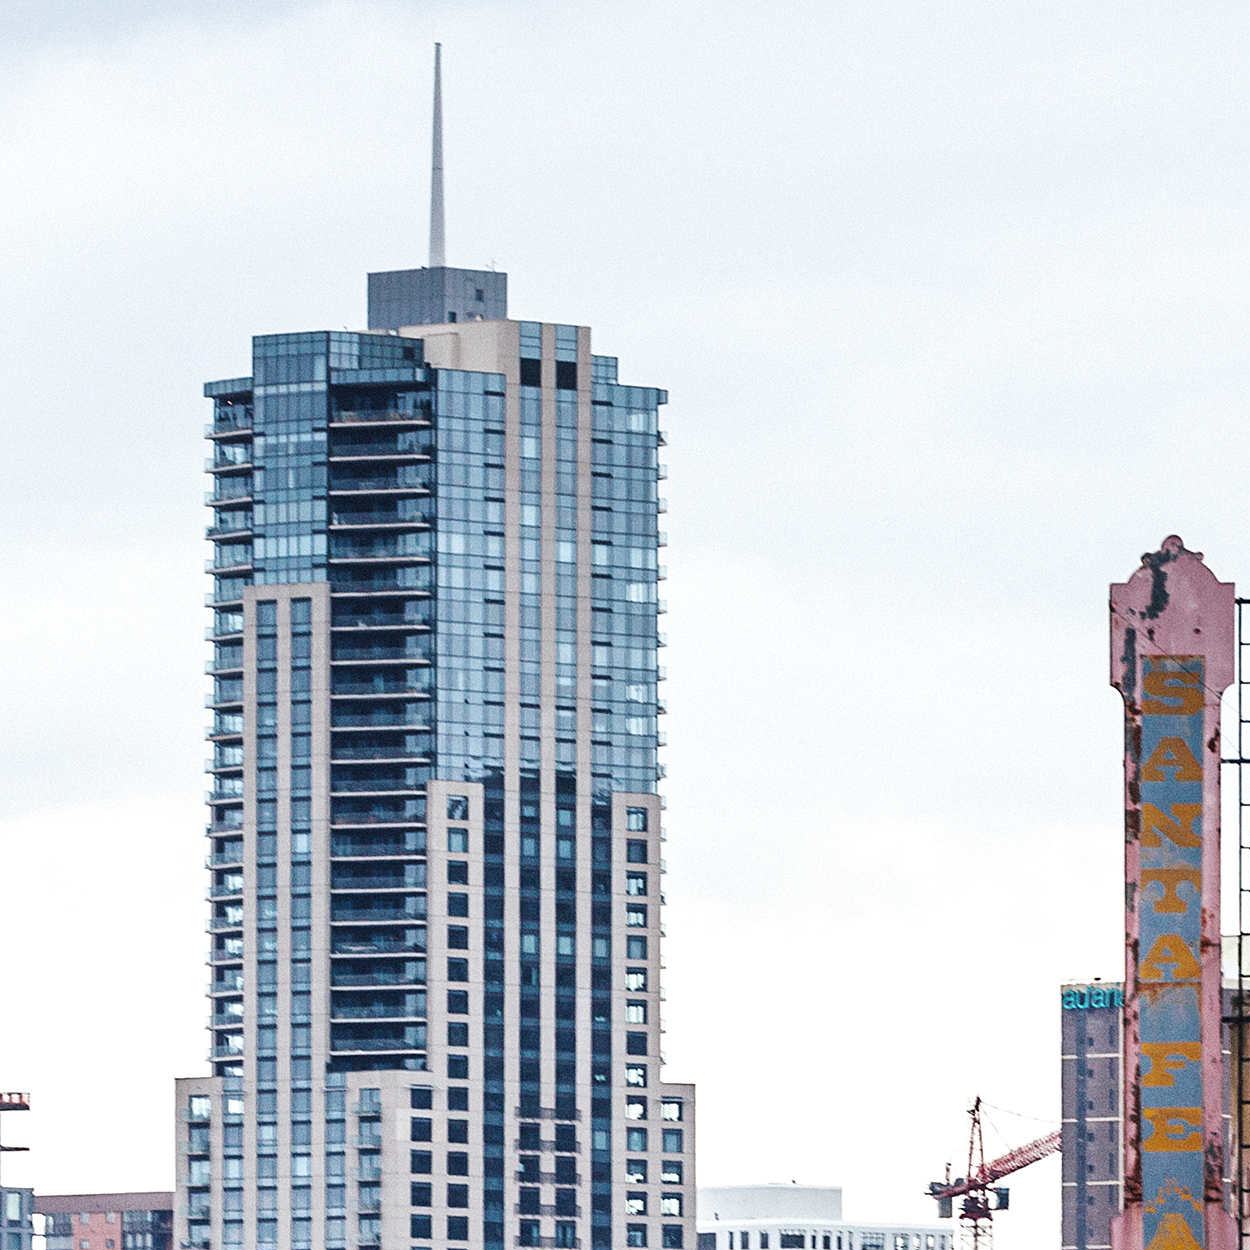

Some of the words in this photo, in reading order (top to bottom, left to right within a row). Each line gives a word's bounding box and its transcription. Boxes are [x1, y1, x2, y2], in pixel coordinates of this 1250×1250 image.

[1139, 670, 1205, 981] SANTA
[1062, 982, 1124, 1010] aurari
[1141, 1041, 1203, 1153] FE
